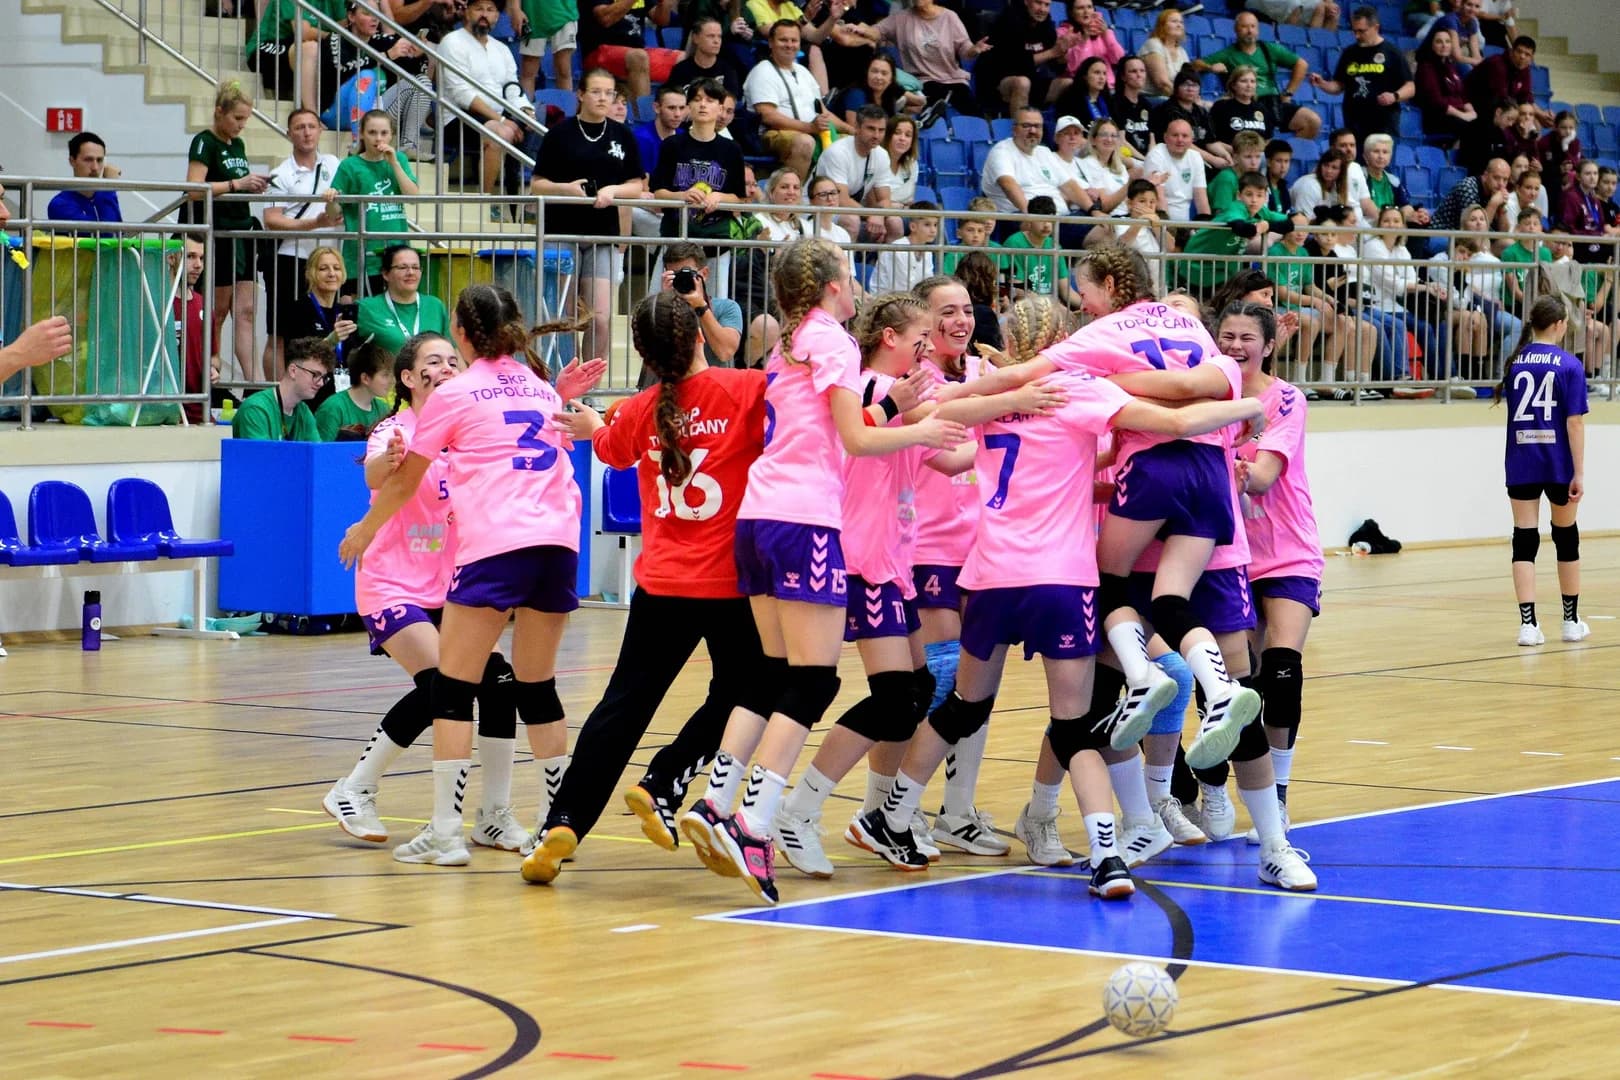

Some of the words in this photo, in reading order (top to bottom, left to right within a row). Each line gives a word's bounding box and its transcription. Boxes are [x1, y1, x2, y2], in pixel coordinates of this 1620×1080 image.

[1513, 371, 1558, 421] 24
[503, 410, 558, 471] 3
[438, 480, 450, 500] 5
[647, 448, 723, 521] 16
[984, 433, 1021, 510] 7
[831, 568, 848, 594] 15
[924, 574, 942, 596] 4
